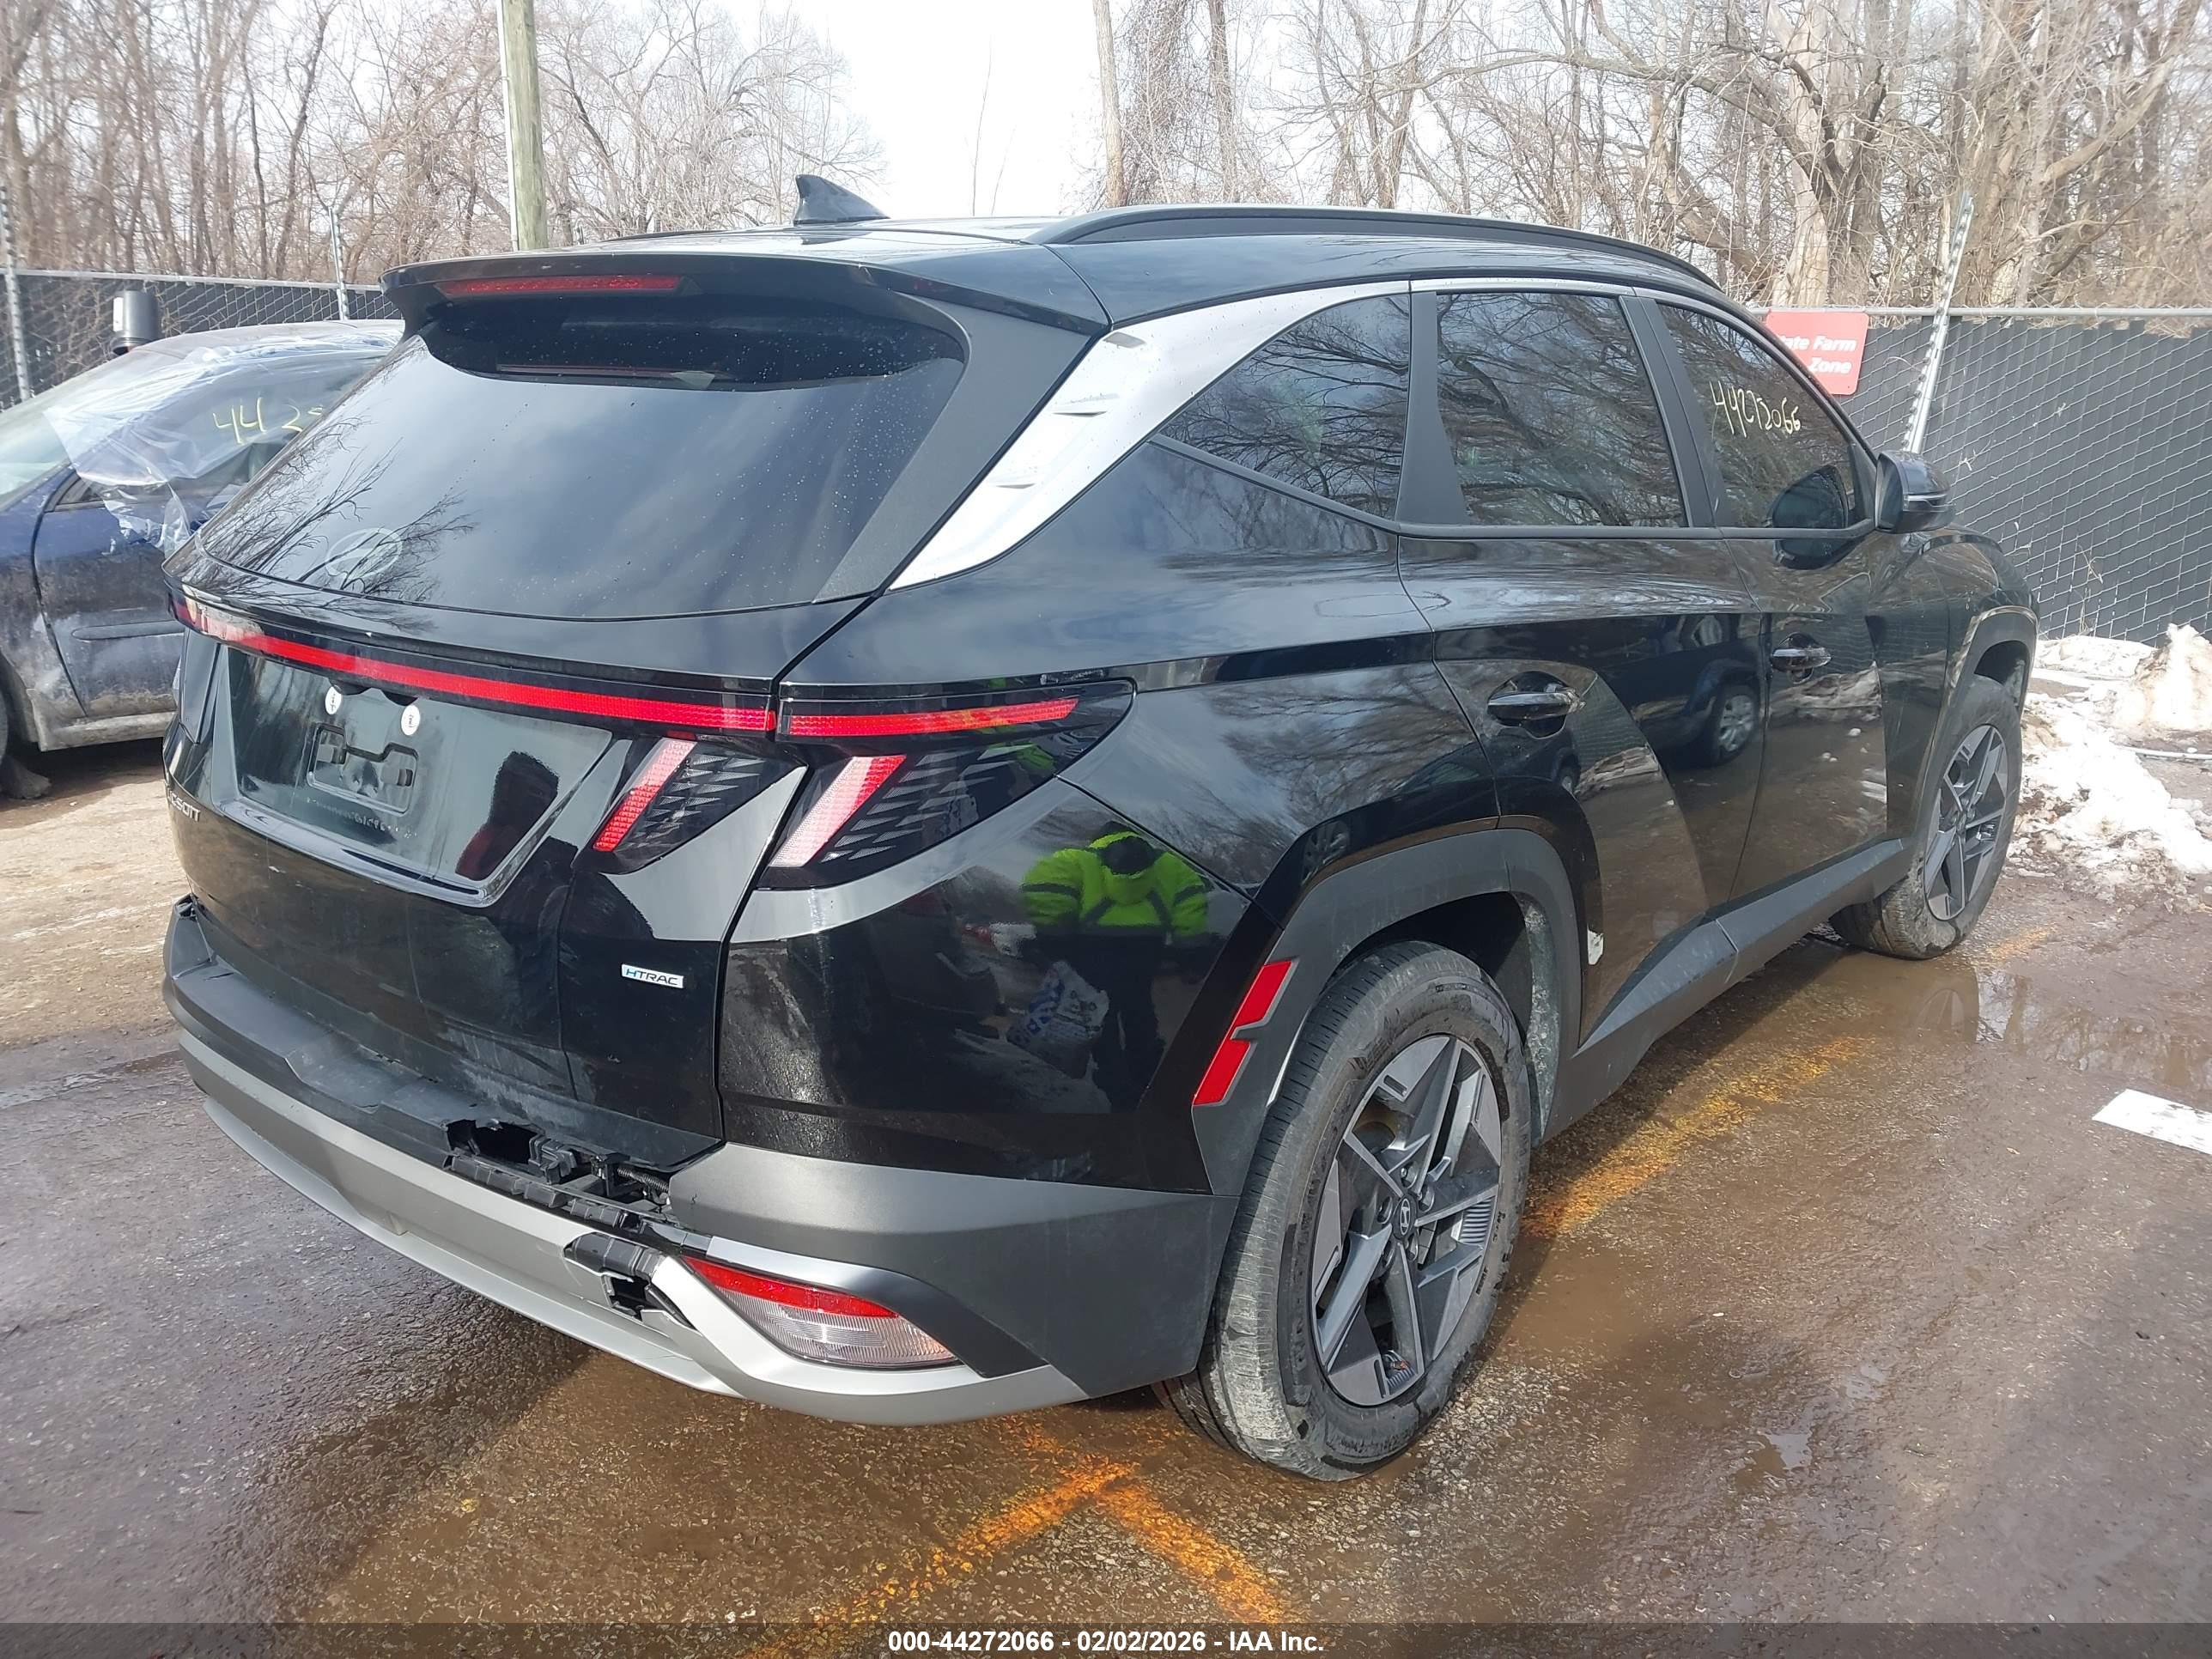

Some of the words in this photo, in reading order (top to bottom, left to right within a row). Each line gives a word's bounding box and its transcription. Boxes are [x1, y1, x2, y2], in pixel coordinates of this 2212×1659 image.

[1779, 335, 1809, 350] tate
[1813, 335, 1856, 351] Farm
[1808, 357, 1852, 374] Zone
[1709, 380, 1802, 438] 44272066
[625, 968, 678, 986] HTRAC
